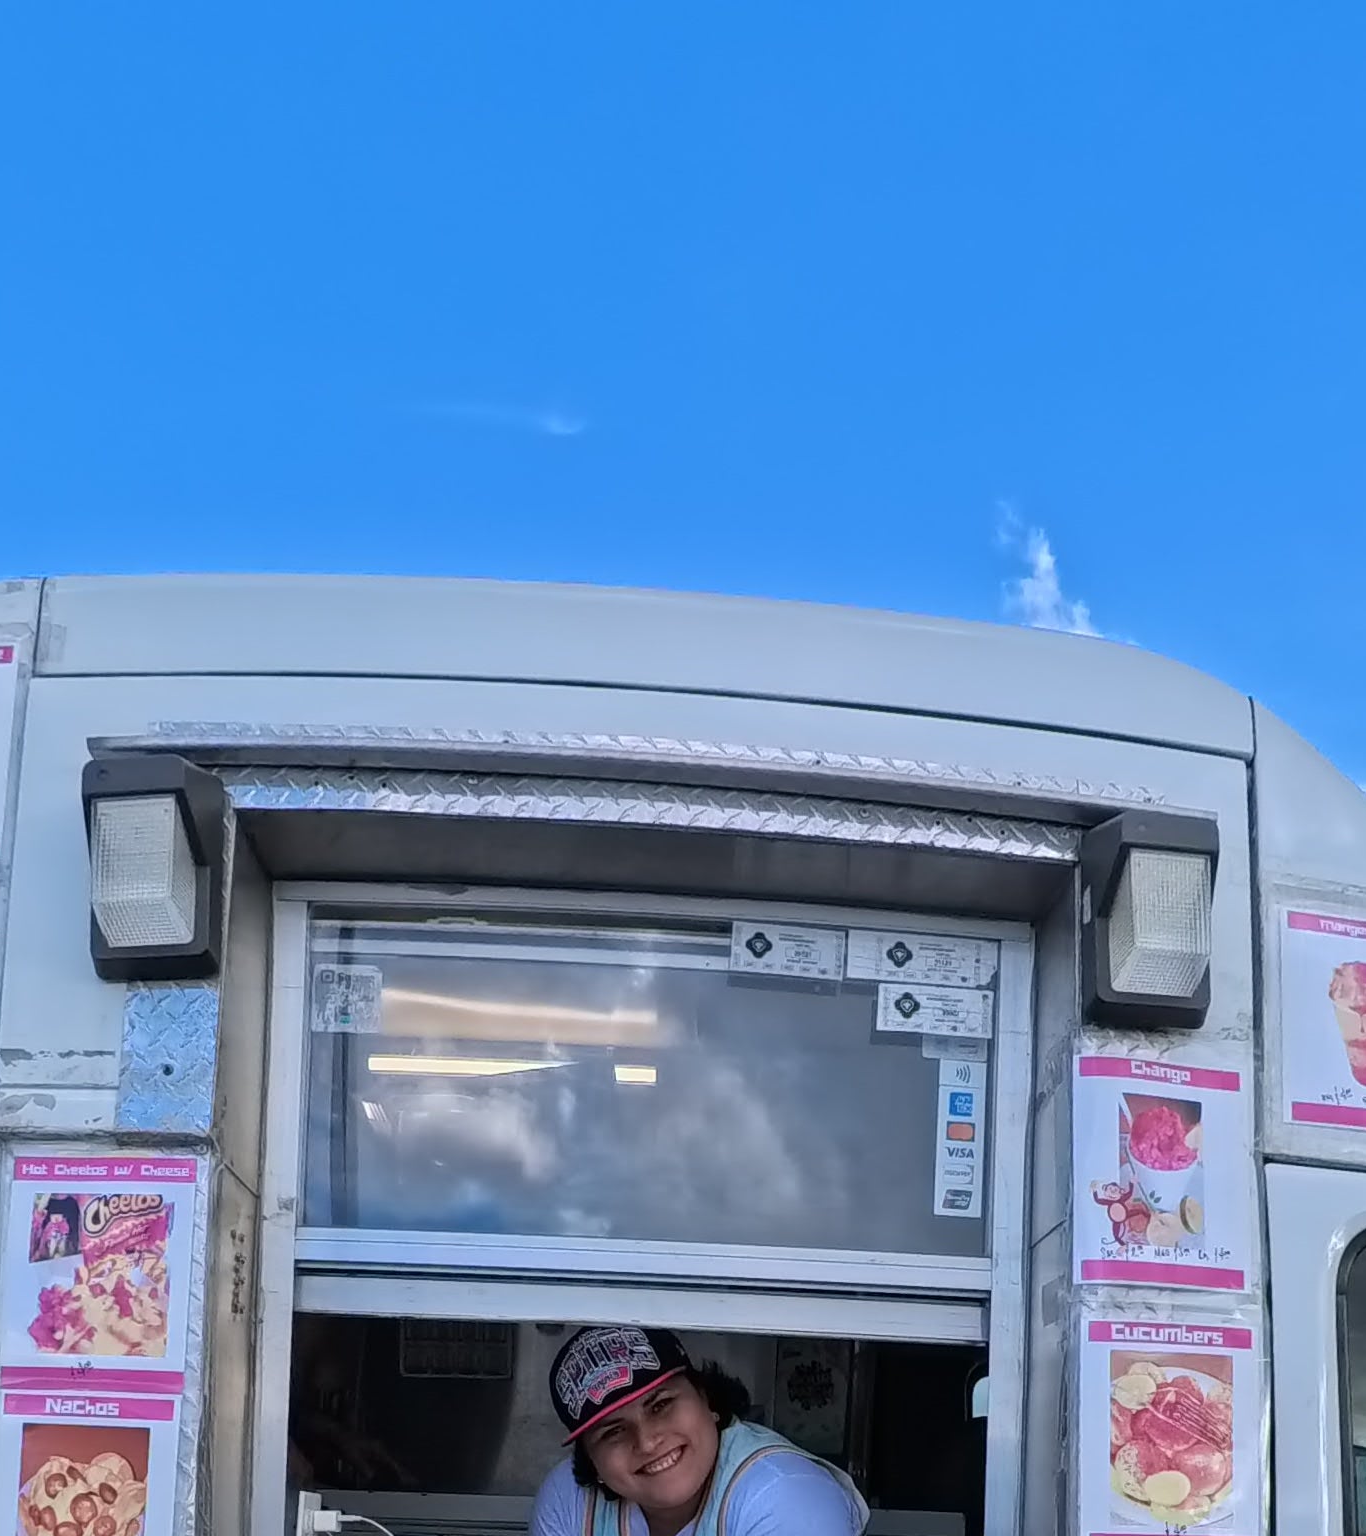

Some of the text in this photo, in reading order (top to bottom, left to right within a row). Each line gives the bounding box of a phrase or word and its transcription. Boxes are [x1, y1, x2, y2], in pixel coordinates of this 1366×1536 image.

[1131, 1061, 1191, 1083] Chango
[945, 1147, 974, 1159] VISA
[22, 1164, 48, 1175] Hot
[54, 1164, 108, 1176] Cheetos
[140, 1165, 190, 1177] Cheese
[1111, 1323, 1224, 1345] Cucumbers
[45, 1397, 119, 1417] Nachos
